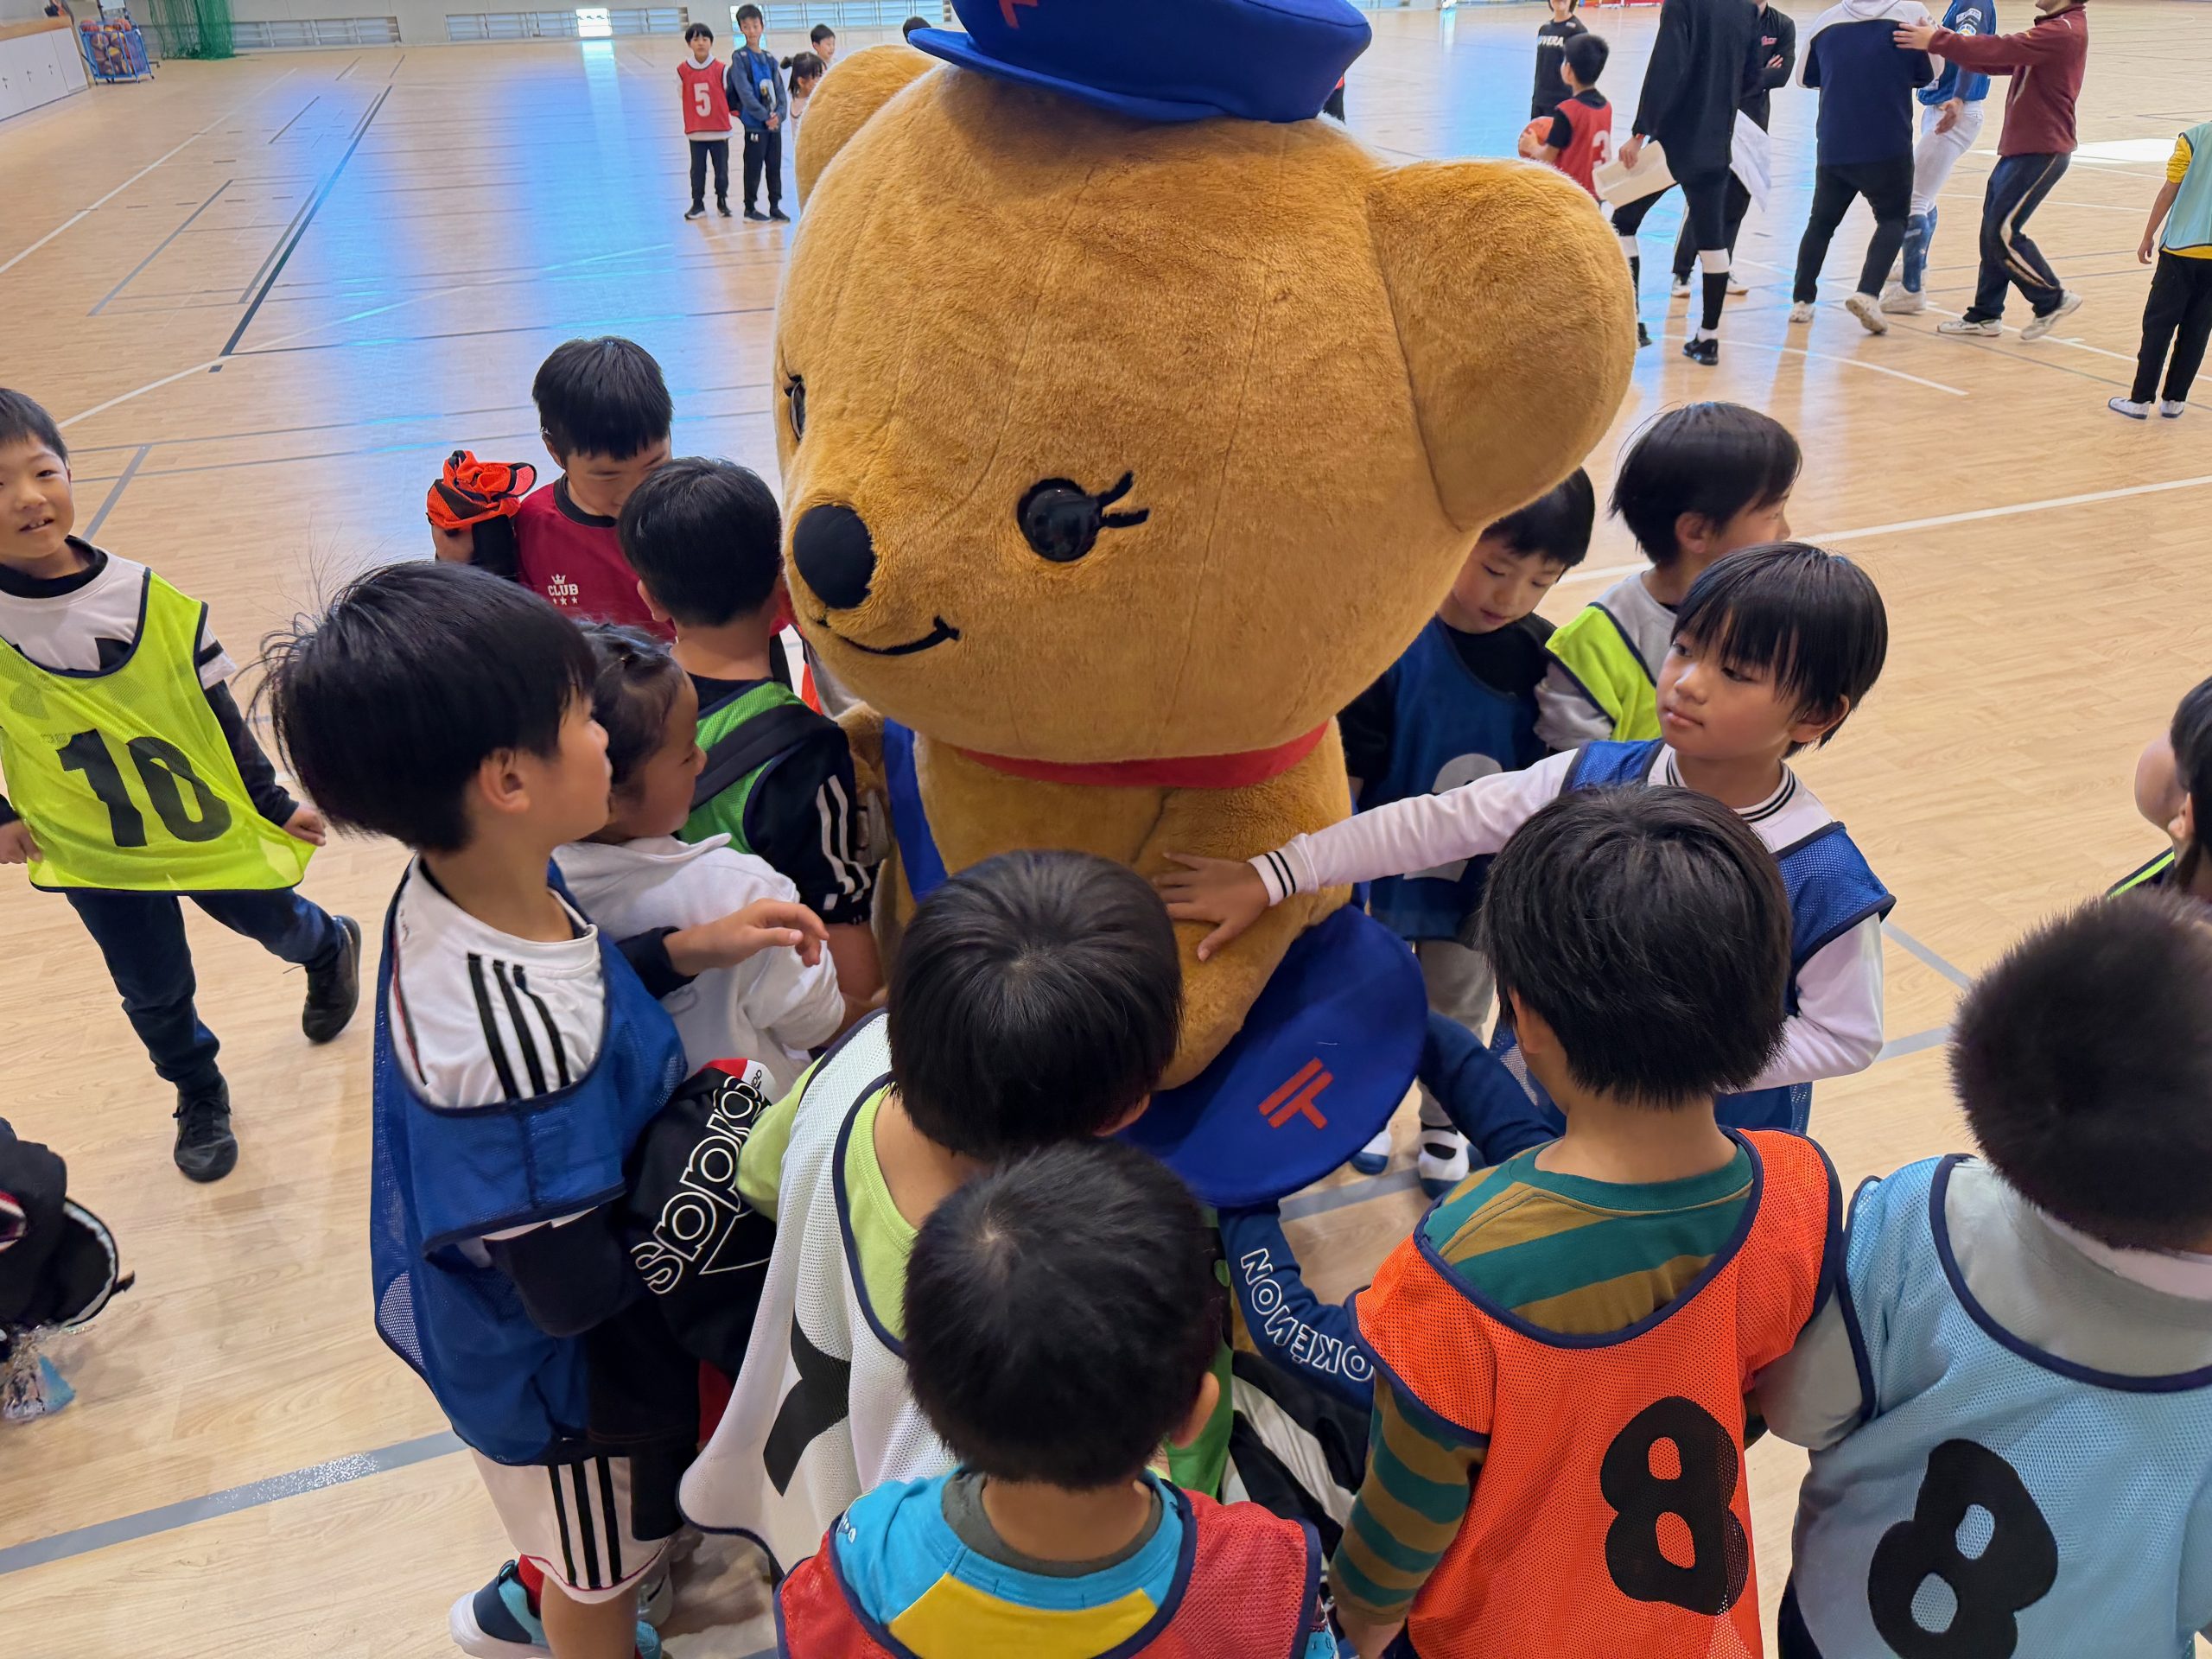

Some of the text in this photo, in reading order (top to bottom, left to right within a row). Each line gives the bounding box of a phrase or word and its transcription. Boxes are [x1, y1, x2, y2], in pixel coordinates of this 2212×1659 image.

[693, 82, 712, 118] 5
[1592, 130, 1611, 168] 3
[547, 583, 580, 597] CLUB
[56, 728, 232, 848] 10
[1599, 1395, 1751, 1616] 8
[1867, 1438, 2059, 1659] 8
